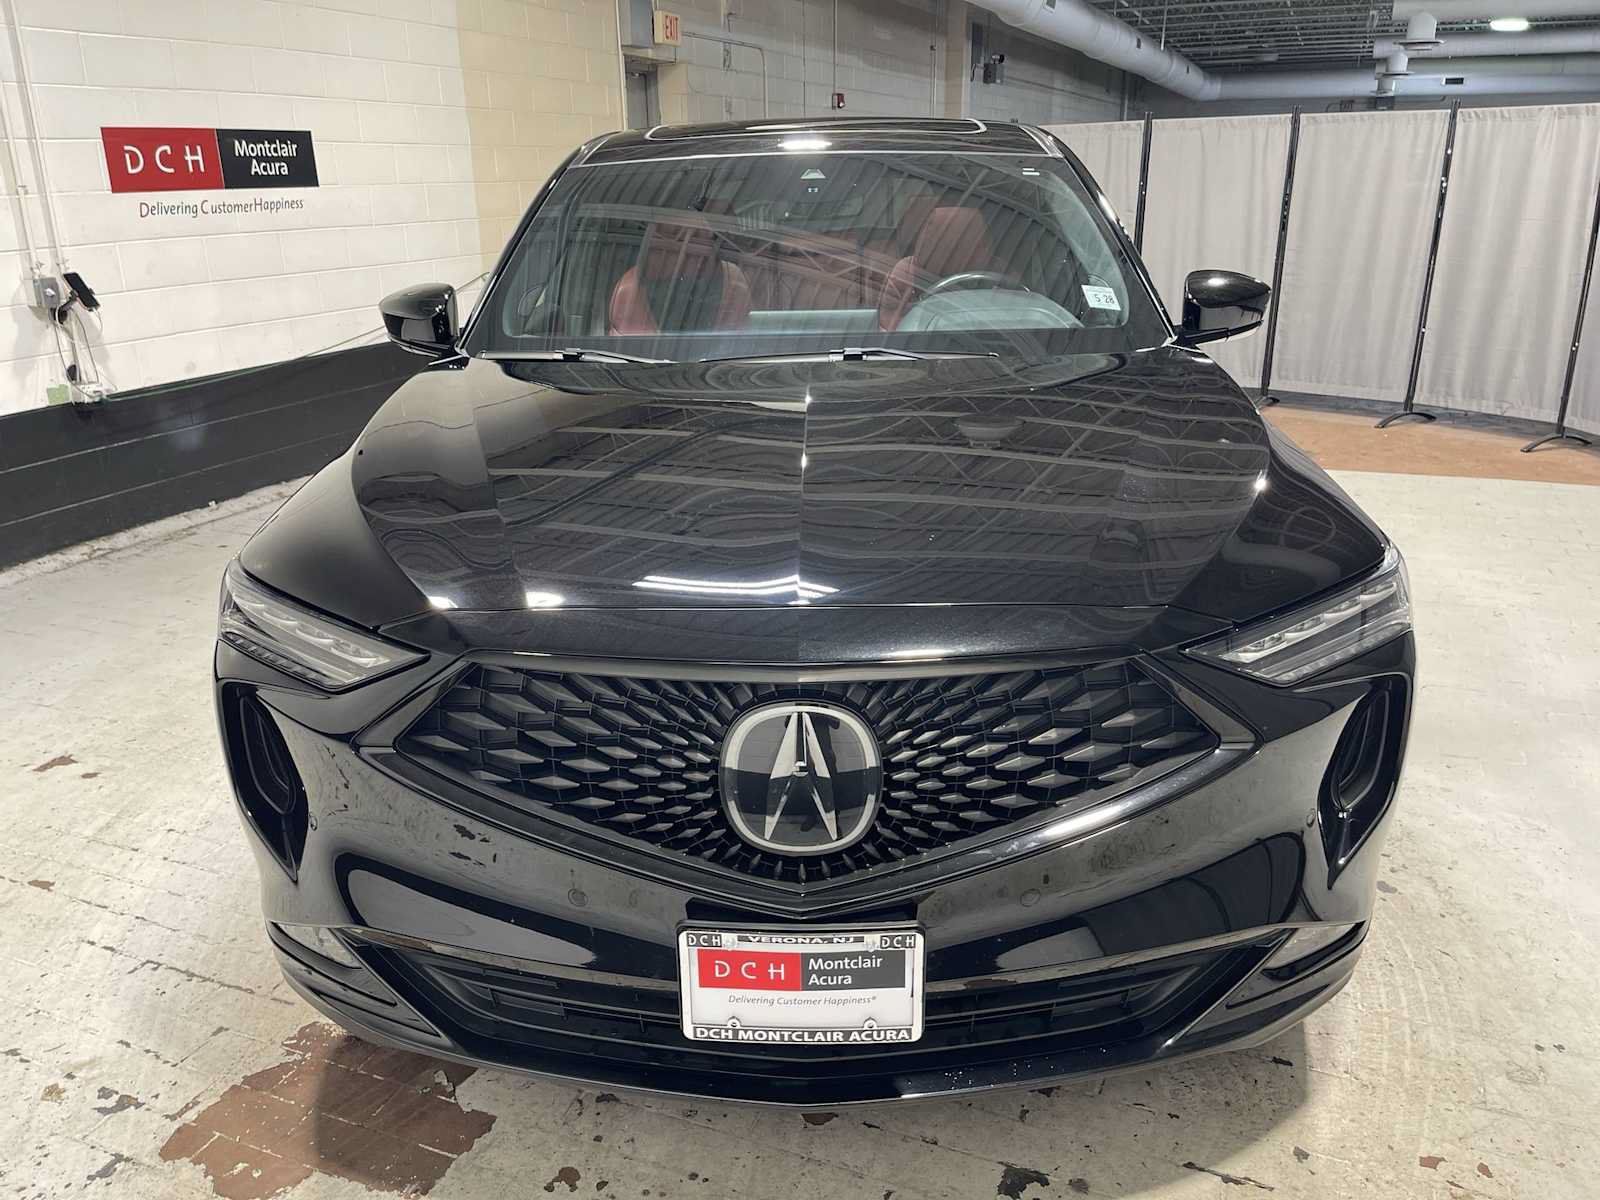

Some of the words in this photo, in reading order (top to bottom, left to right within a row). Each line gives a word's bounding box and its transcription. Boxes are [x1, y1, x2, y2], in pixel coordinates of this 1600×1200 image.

[664, 15, 679, 41] EXIT
[234, 139, 298, 158] Montclair
[123, 144, 205, 175] DCH
[250, 158, 289, 176] Acura
[139, 201, 198, 218] Delivering
[687, 934, 722, 946] DCH
[748, 935, 827, 945] VERONA,
[836, 935, 855, 944] NJ
[881, 935, 915, 948] DCH
[714, 959, 785, 981] DCH
[808, 955, 883, 971] Montclair
[808, 973, 853, 986] Acura
[728, 994, 775, 1007] Delivering
[776, 995, 822, 1006] Customer
[695, 1027, 733, 1040] DCH
[737, 1029, 844, 1042] MONTCLAIR
[851, 1028, 910, 1041] ACURA
